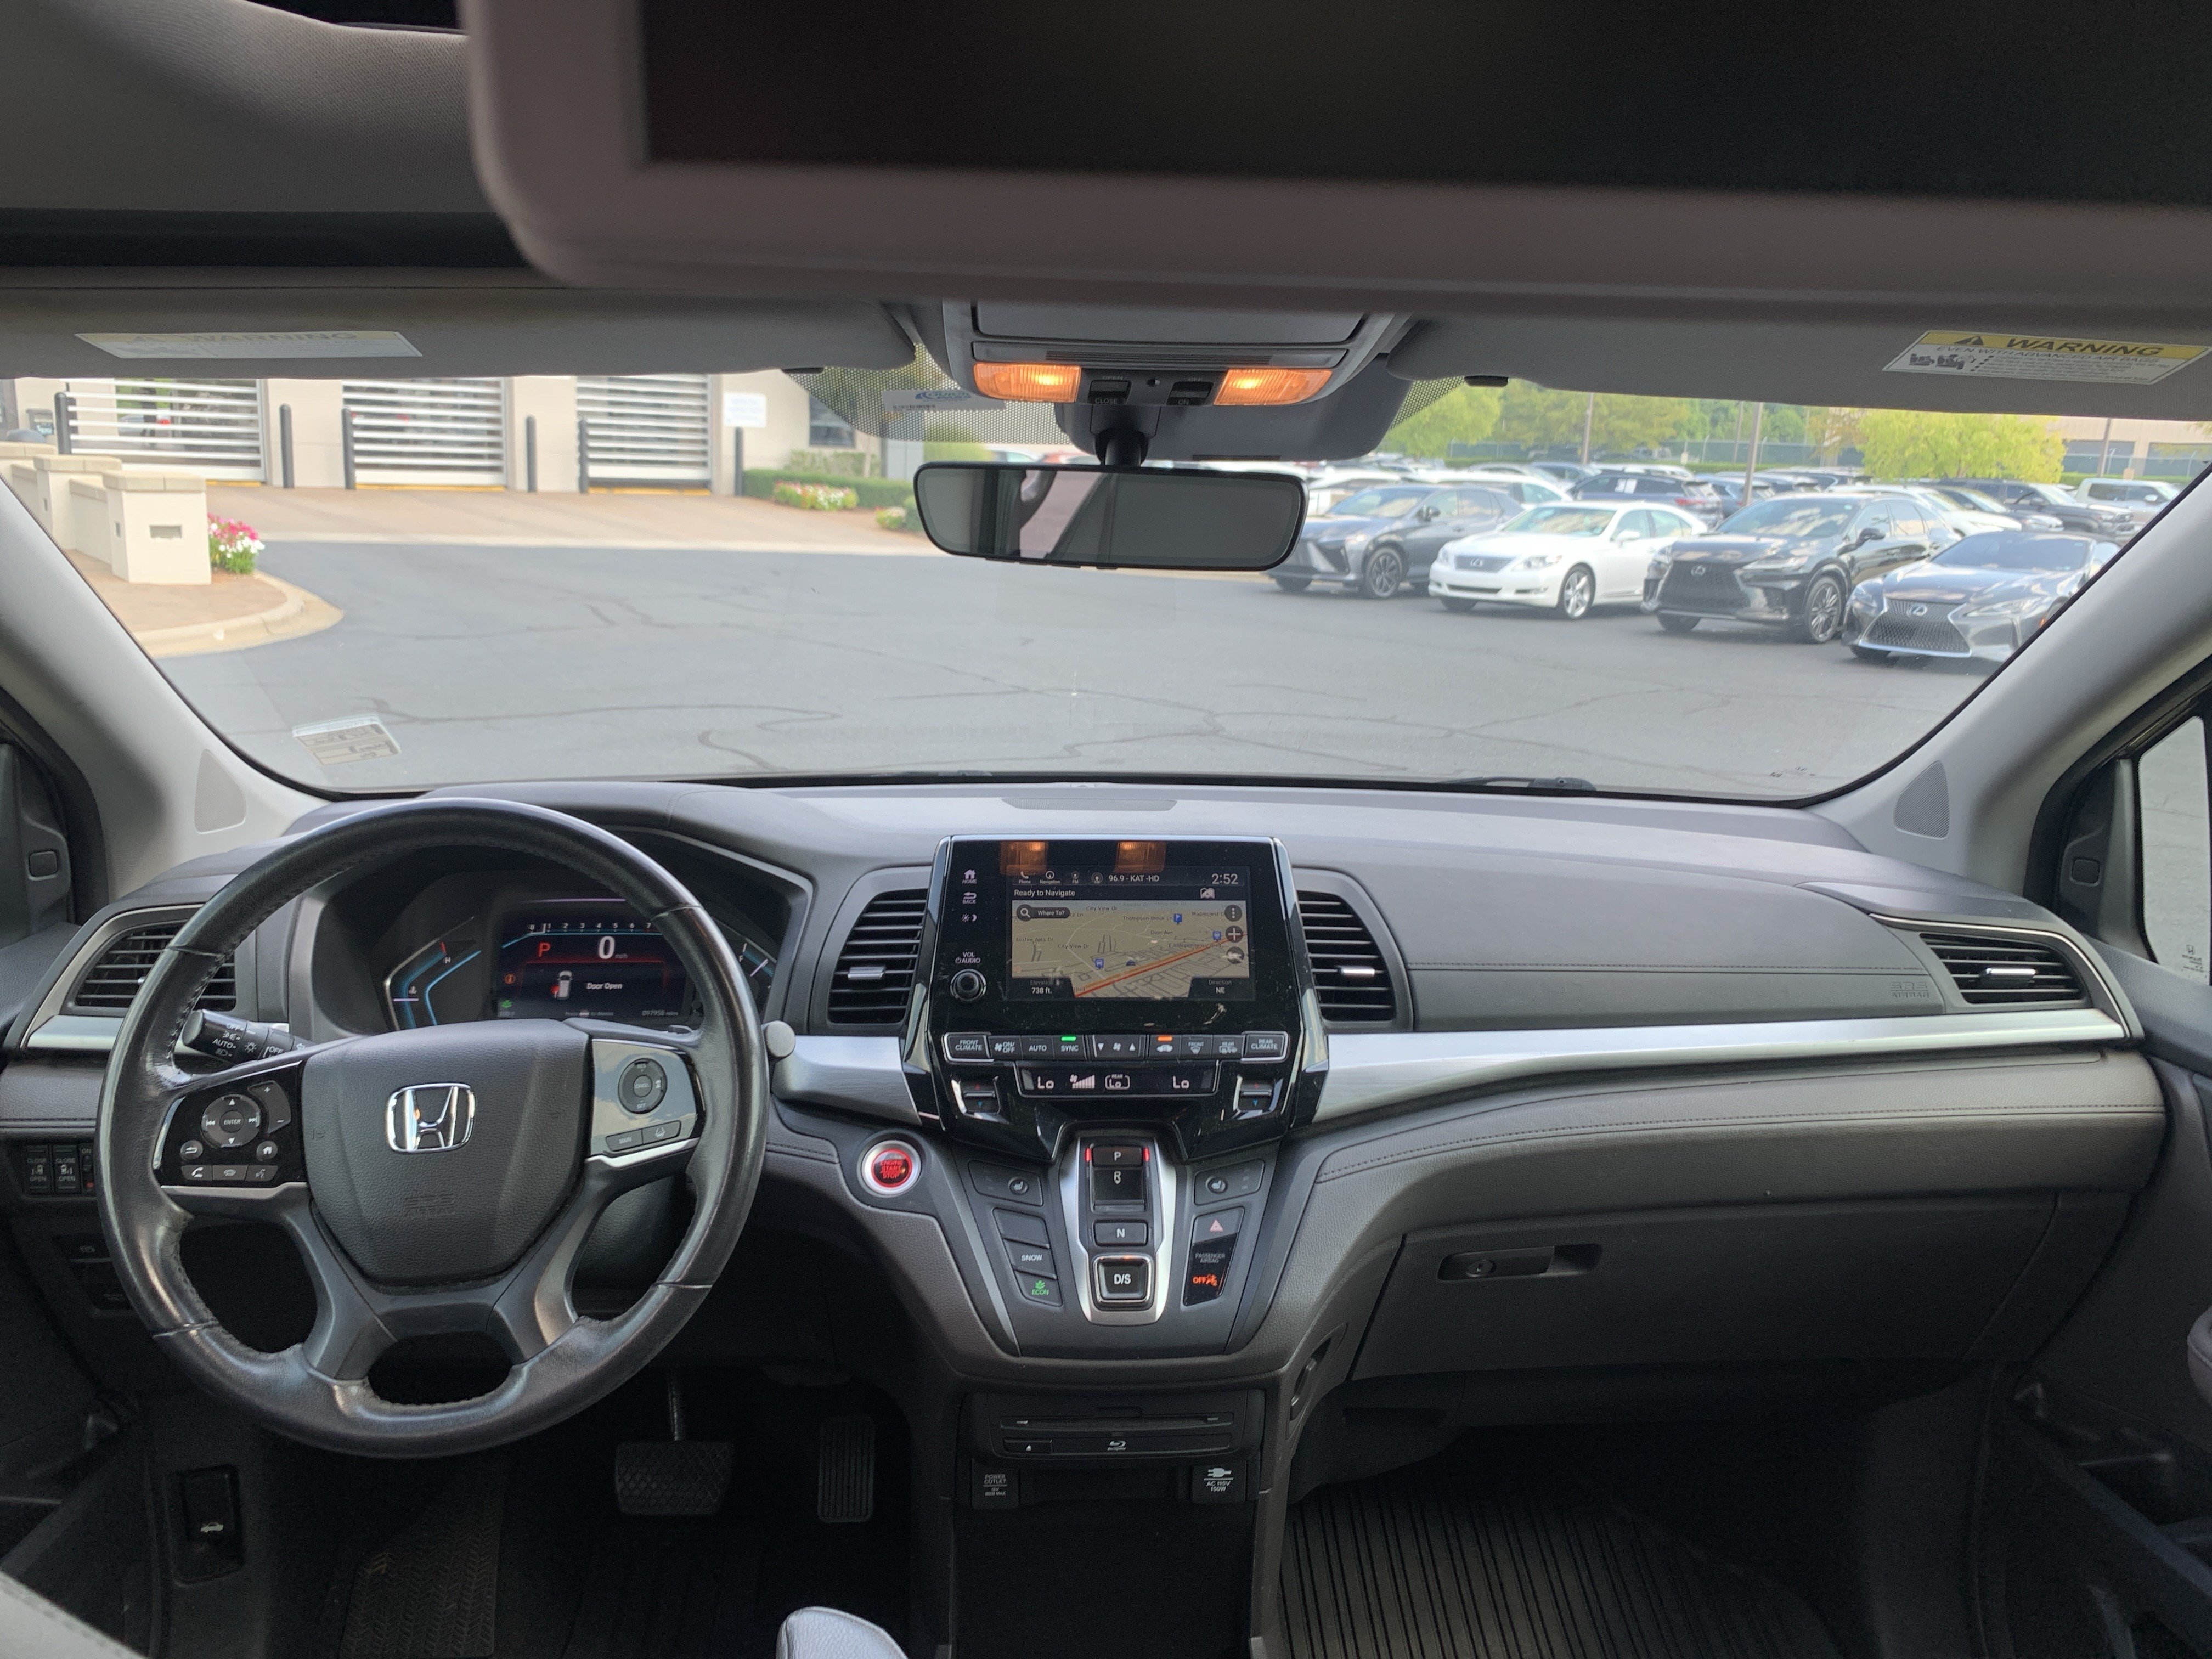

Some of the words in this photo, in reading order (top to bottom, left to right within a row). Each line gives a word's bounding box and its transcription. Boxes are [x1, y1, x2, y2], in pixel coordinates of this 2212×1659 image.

[2007, 338, 2164, 356] WARNING
[1211, 873, 1239, 884] 2:52
[1014, 889, 1035, 898] Ready
[1045, 889, 1075, 898] Navigate
[538, 941, 551, 957] P
[598, 935, 616, 960] 0
[605, 982, 623, 990] Open
[227, 1023, 240, 1031] OFF
[213, 1038, 233, 1049] AUTO
[1037, 1076, 1055, 1090] Lo
[1109, 1079, 1121, 1088] Lo
[1172, 1075, 1190, 1089] Lo
[1114, 1152, 1121, 1161] P
[1114, 1171, 1121, 1181] R
[1116, 1228, 1125, 1238] N
[1021, 1254, 1043, 1262] SNOW
[1114, 1273, 1131, 1285] D/S
[1193, 1276, 1207, 1284] OFF
